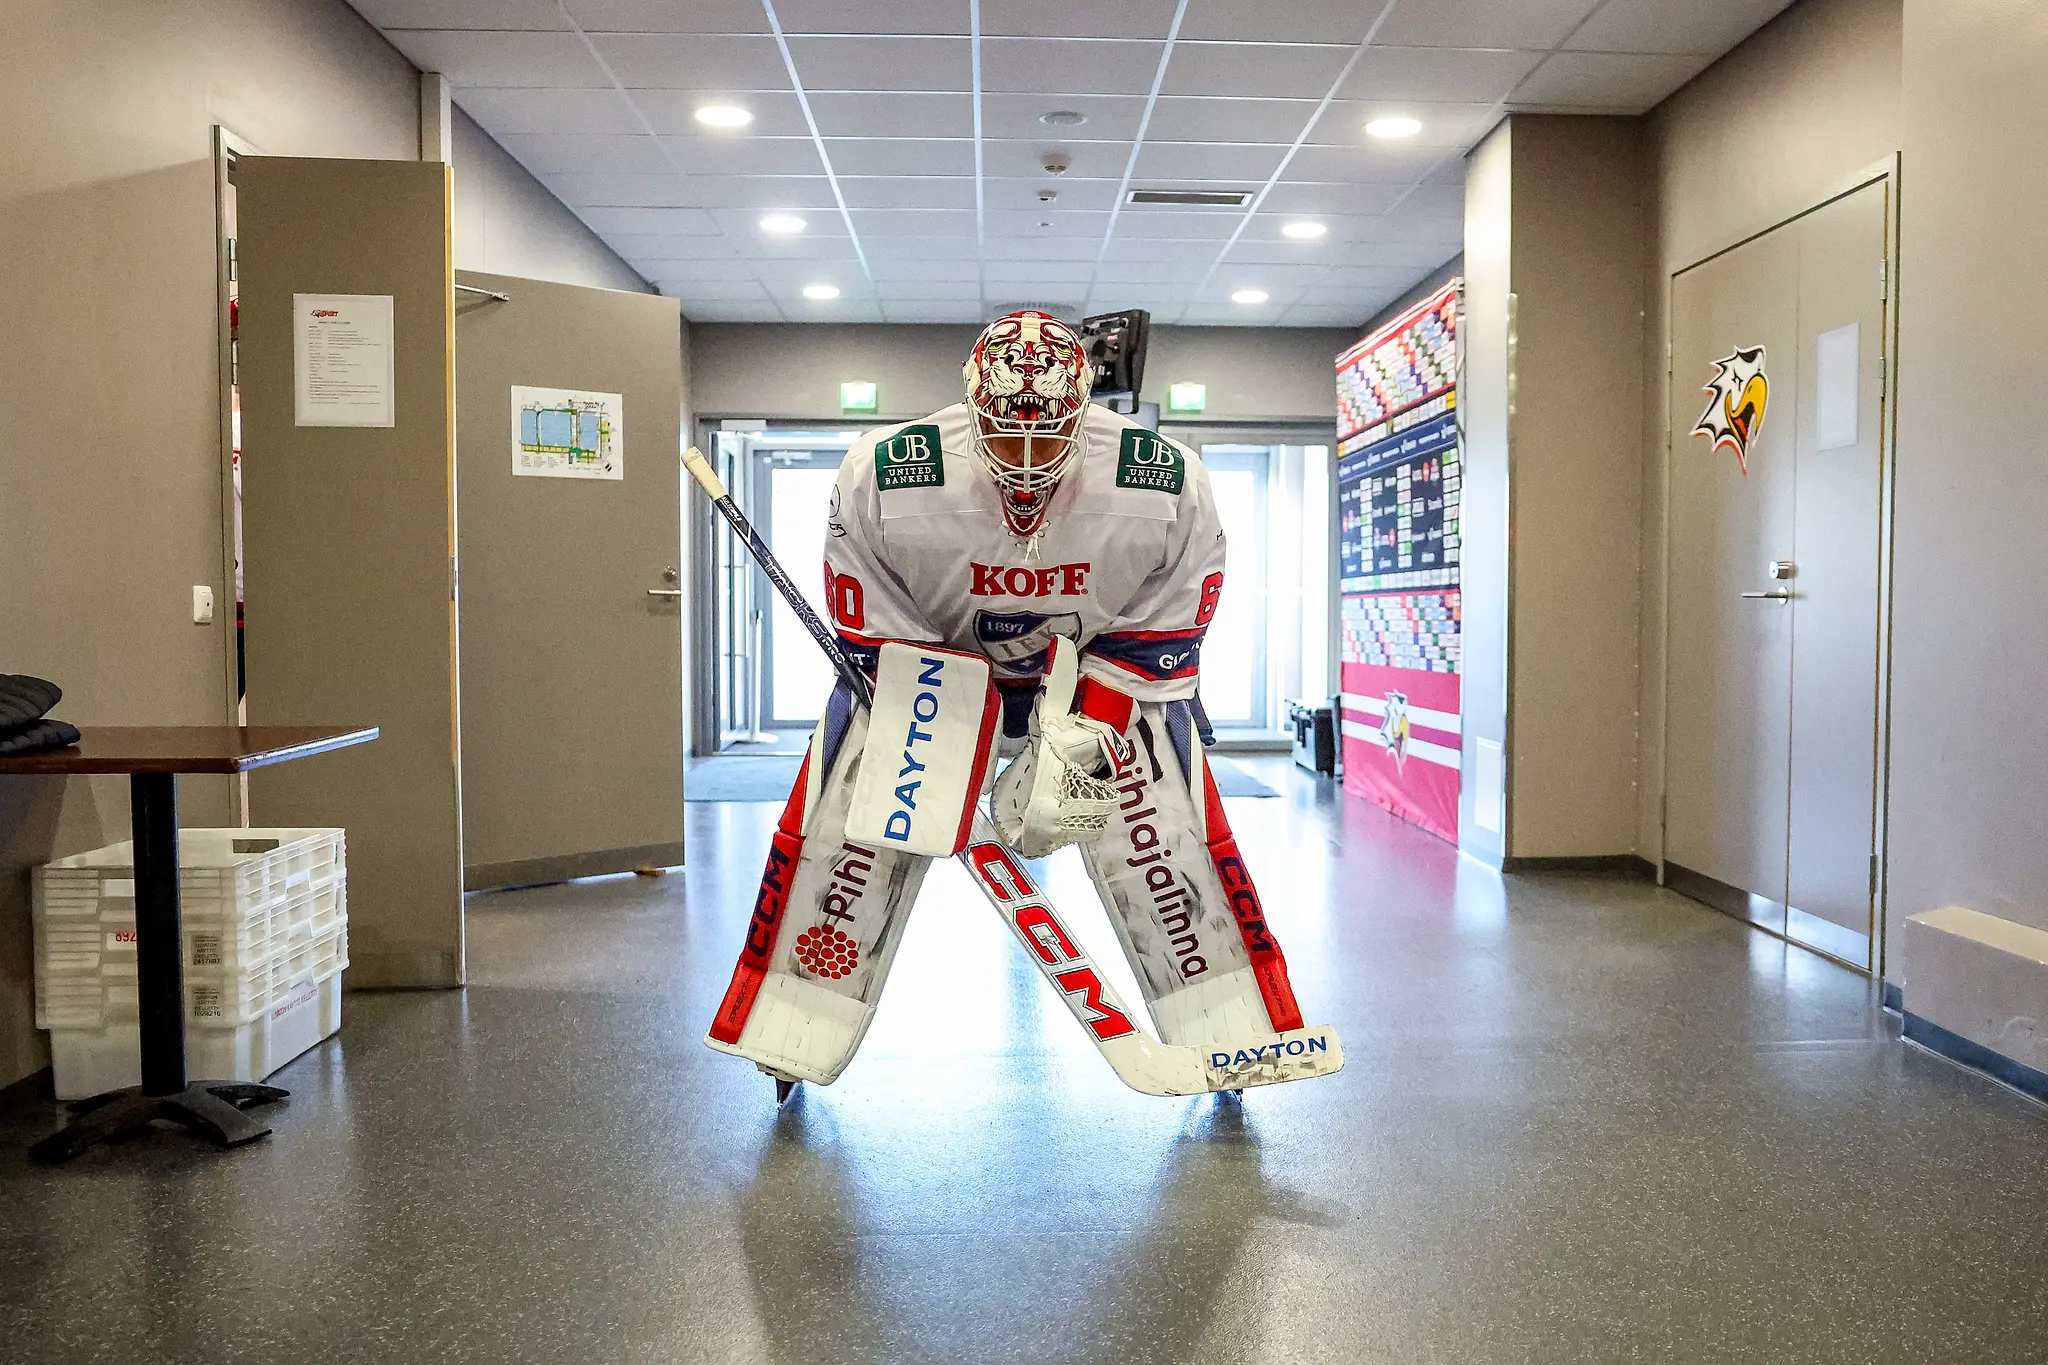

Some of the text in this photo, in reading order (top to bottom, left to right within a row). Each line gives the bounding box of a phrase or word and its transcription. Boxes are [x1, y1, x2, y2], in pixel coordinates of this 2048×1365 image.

[885, 434, 931, 463] UB
[1131, 436, 1175, 466] UB
[885, 474, 937, 485] BANKERS
[888, 466, 932, 477] UNITED
[1124, 475, 1176, 489] BANKERS
[1130, 468, 1173, 480] UNITED
[762, 555, 846, 666] TACKS PRO
[985, 620, 1025, 634] 1897
[883, 657, 945, 842] DAYTON
[748, 846, 790, 957] CCM
[1218, 856, 1275, 953] CCM
[966, 841, 1139, 1041] CCM
[1211, 1036, 1327, 1068] DAYTON
